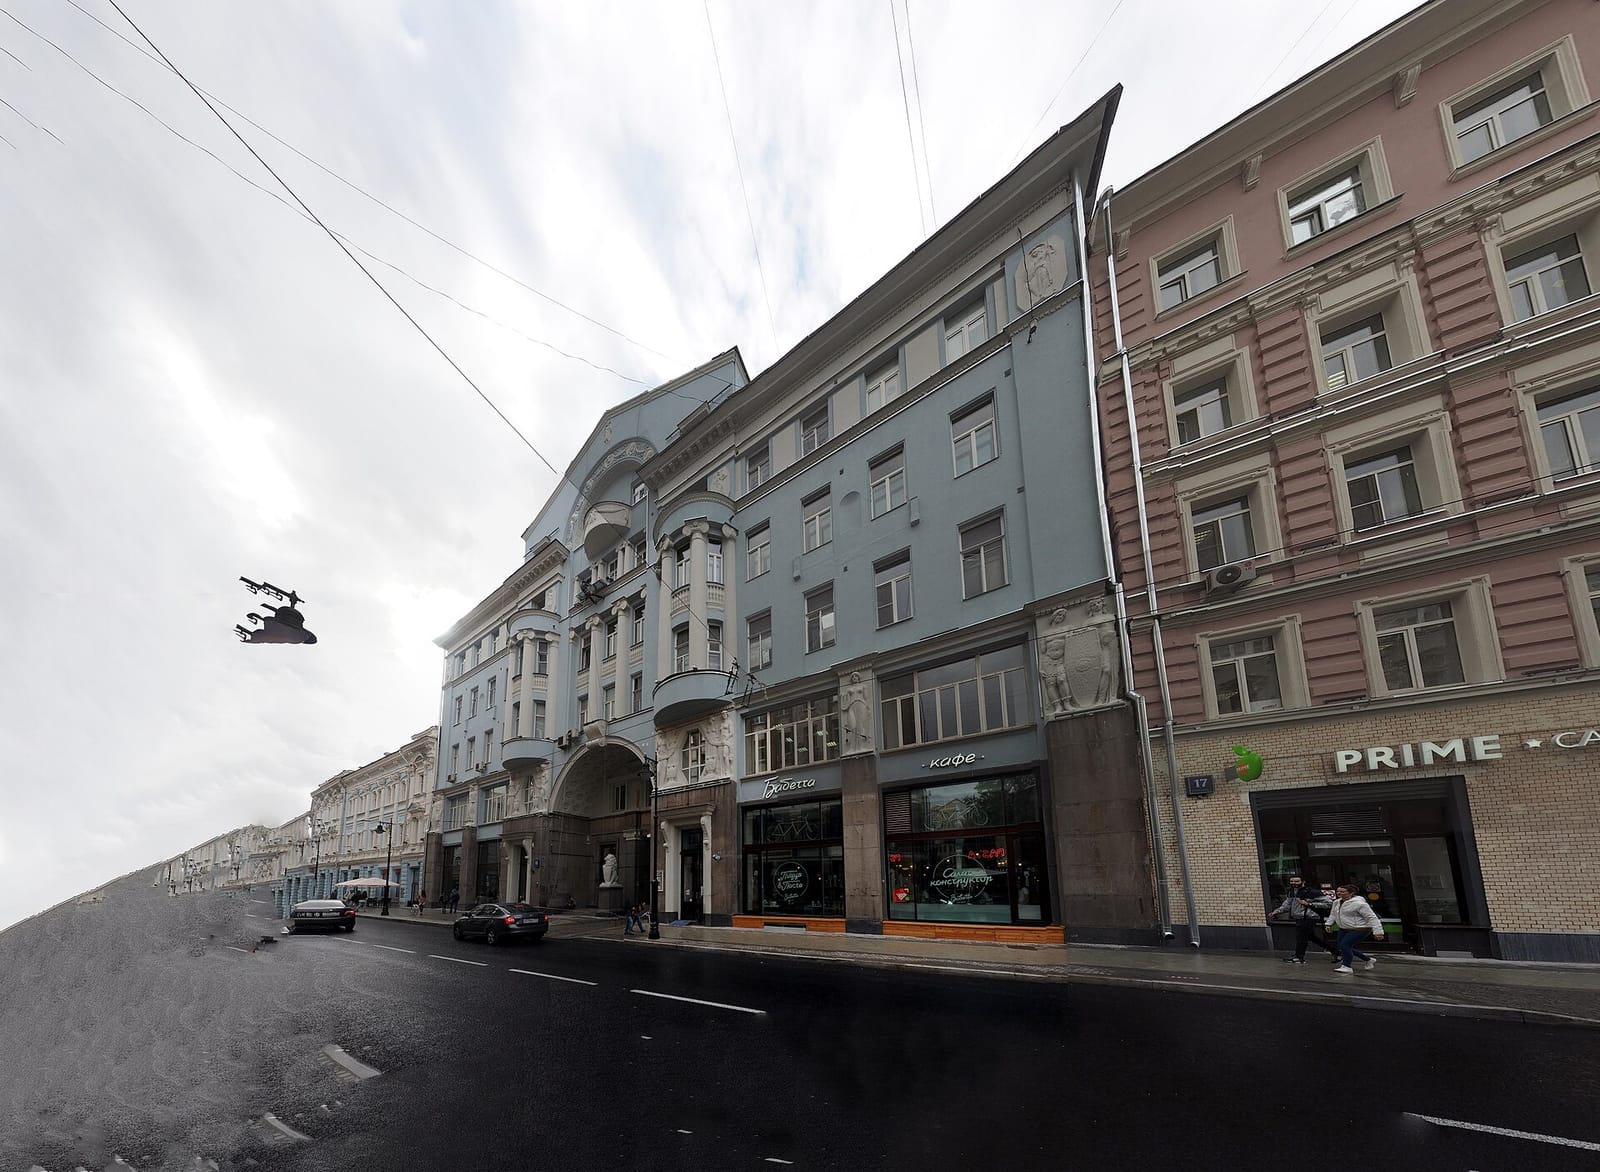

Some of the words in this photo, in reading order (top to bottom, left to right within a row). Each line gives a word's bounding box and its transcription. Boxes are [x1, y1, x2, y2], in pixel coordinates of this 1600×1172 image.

[1334, 734, 1503, 773] PRIME
[762, 775, 816, 799] Бабетта
[1194, 778, 1208, 788] 17
